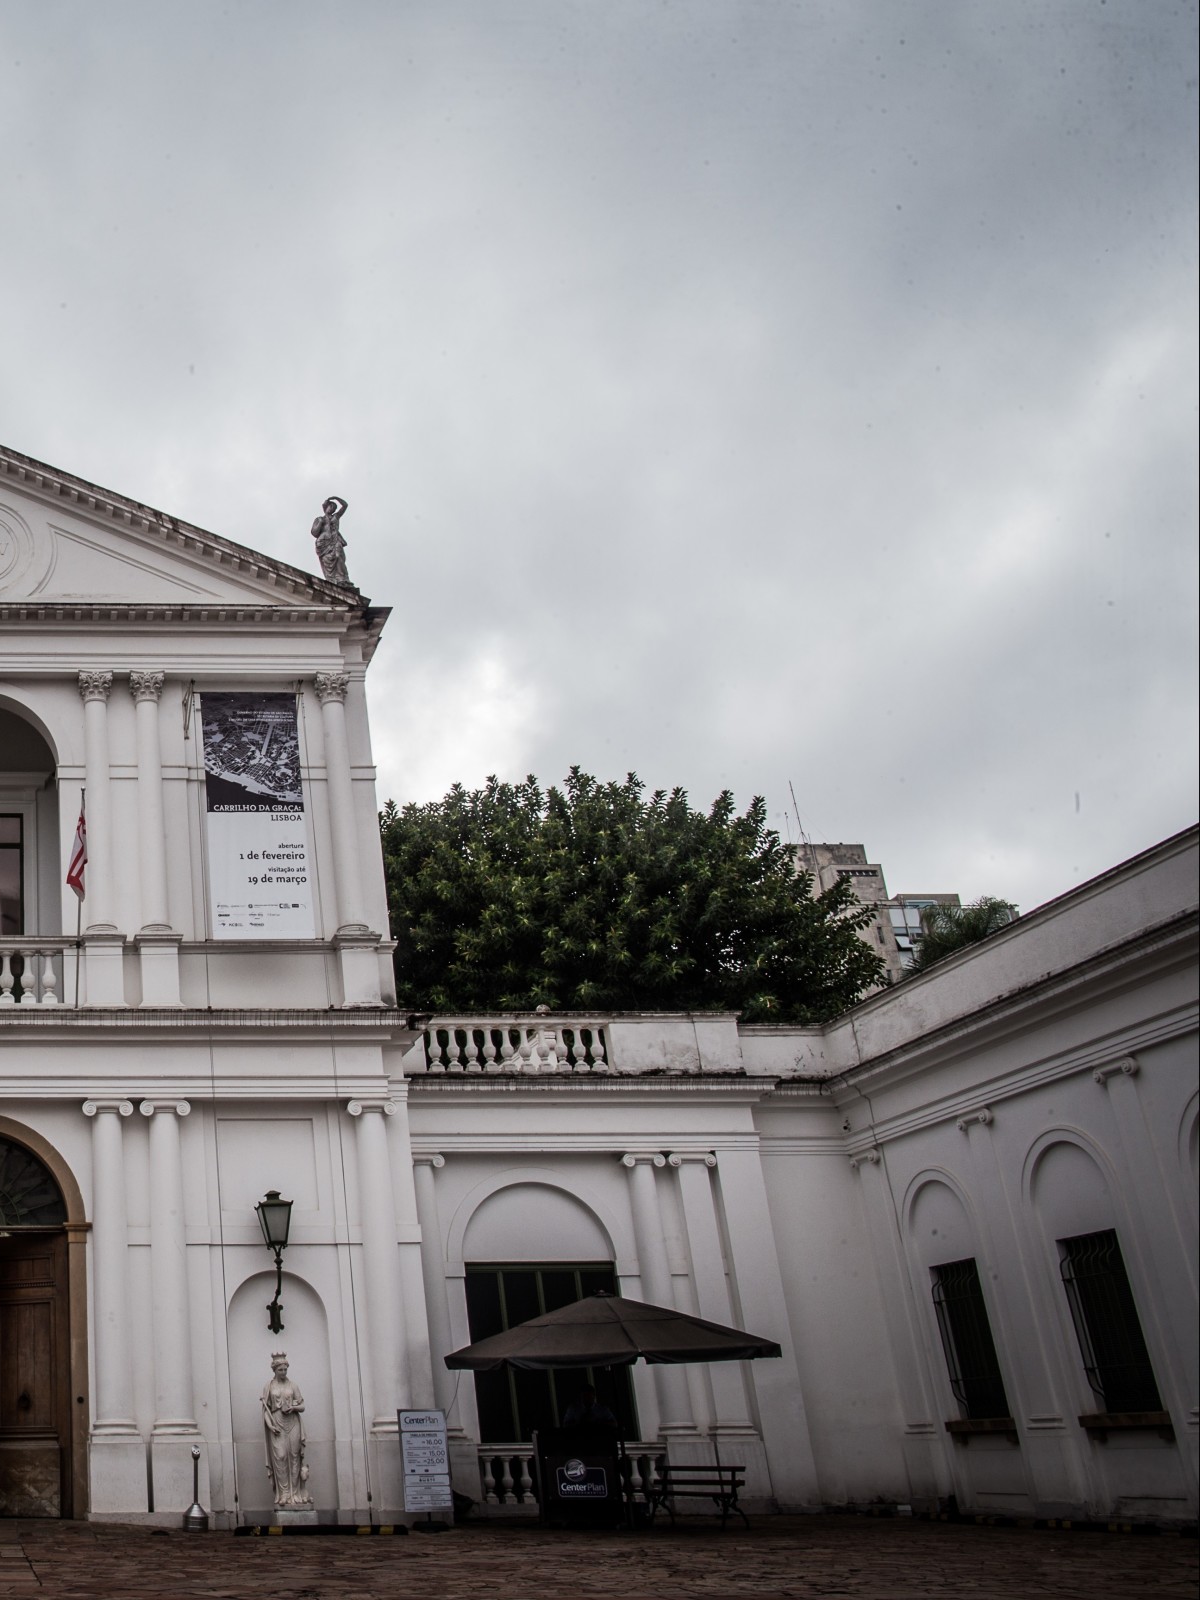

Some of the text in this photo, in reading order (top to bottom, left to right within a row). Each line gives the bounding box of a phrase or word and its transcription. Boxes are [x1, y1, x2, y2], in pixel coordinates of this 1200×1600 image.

[272, 804, 301, 813] GRAÇA:
[247, 850, 259, 860] de
[262, 850, 305, 860] fevereiro
[248, 874, 307, 885] 19 de março
[561, 1483, 604, 1491] CenterPlan
